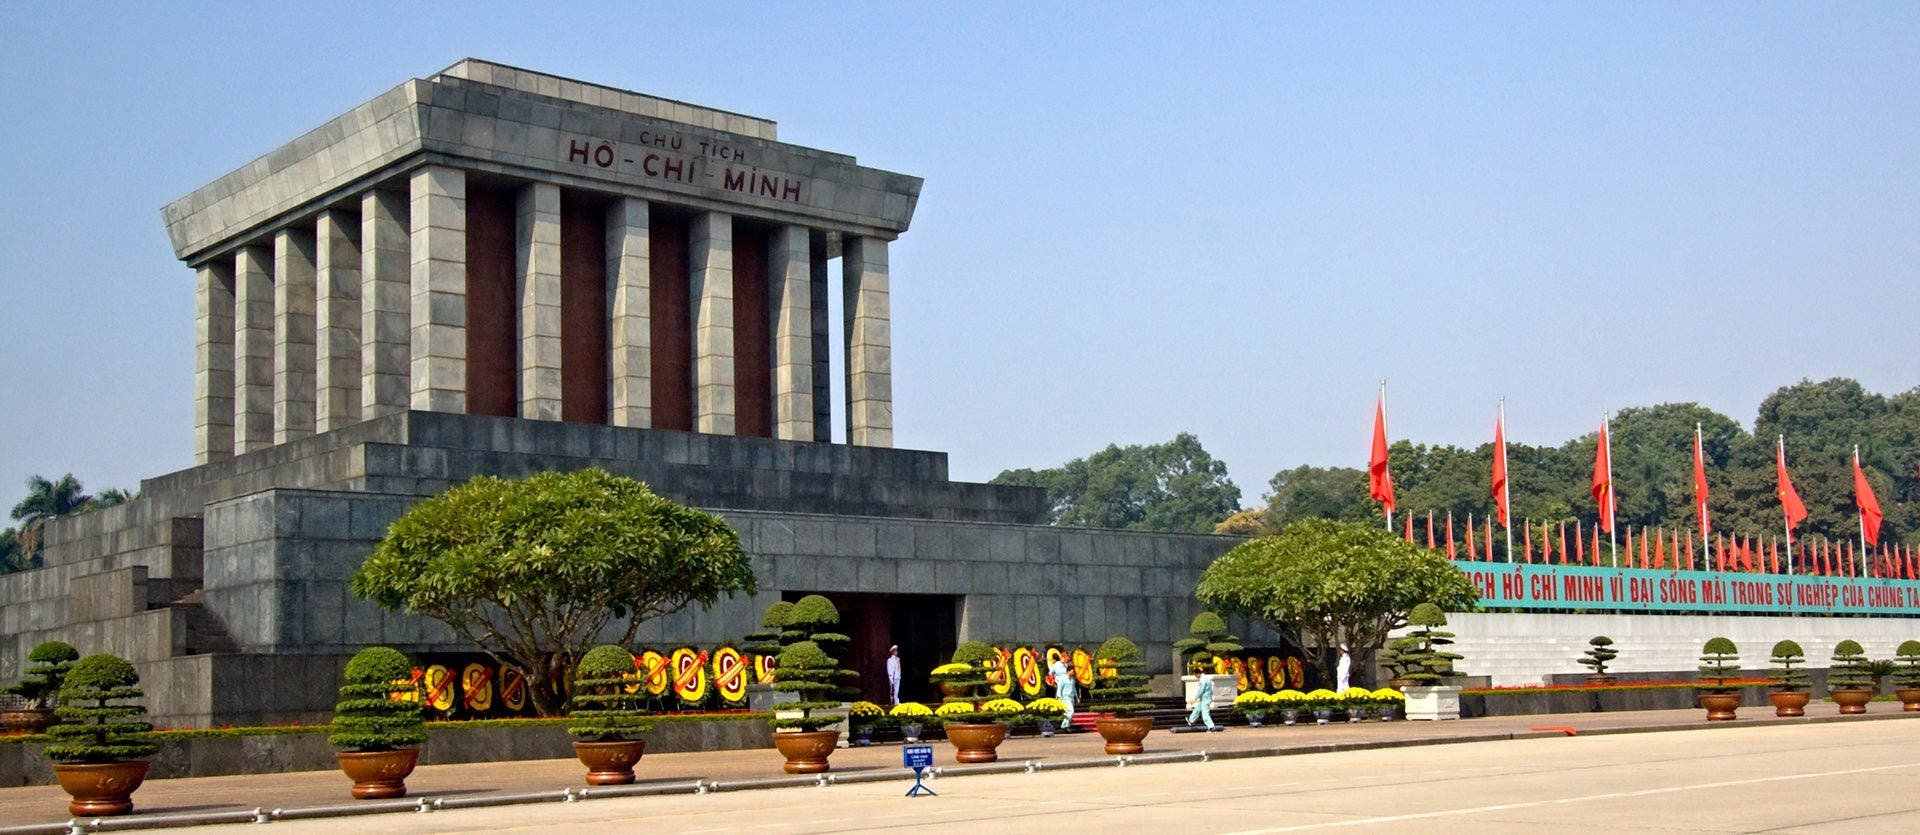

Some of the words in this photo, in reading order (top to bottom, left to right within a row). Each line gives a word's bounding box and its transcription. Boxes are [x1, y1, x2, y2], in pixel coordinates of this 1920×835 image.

[640, 131, 682, 149] CHỦ
[700, 141, 745, 162] TỊCH
[1502, 565, 1524, 600] HỒ
[1531, 568, 1557, 600] CHÍ
[1564, 575, 1604, 601] MINH
[1610, 571, 1624, 602] VĨ
[1630, 576, 1654, 608] ĐẠI
[1660, 571, 1697, 603] SỐNG
[1701, 575, 1727, 604] MÃI
[1731, 581, 1772, 605] TRONG
[1777, 580, 1793, 610] SỰ
[1797, 580, 1838, 611] NGHIỆP
[1842, 578, 1865, 607] CỦA
[1868, 580, 1904, 608] CHÚNG
[1906, 587, 1920, 608] TA
